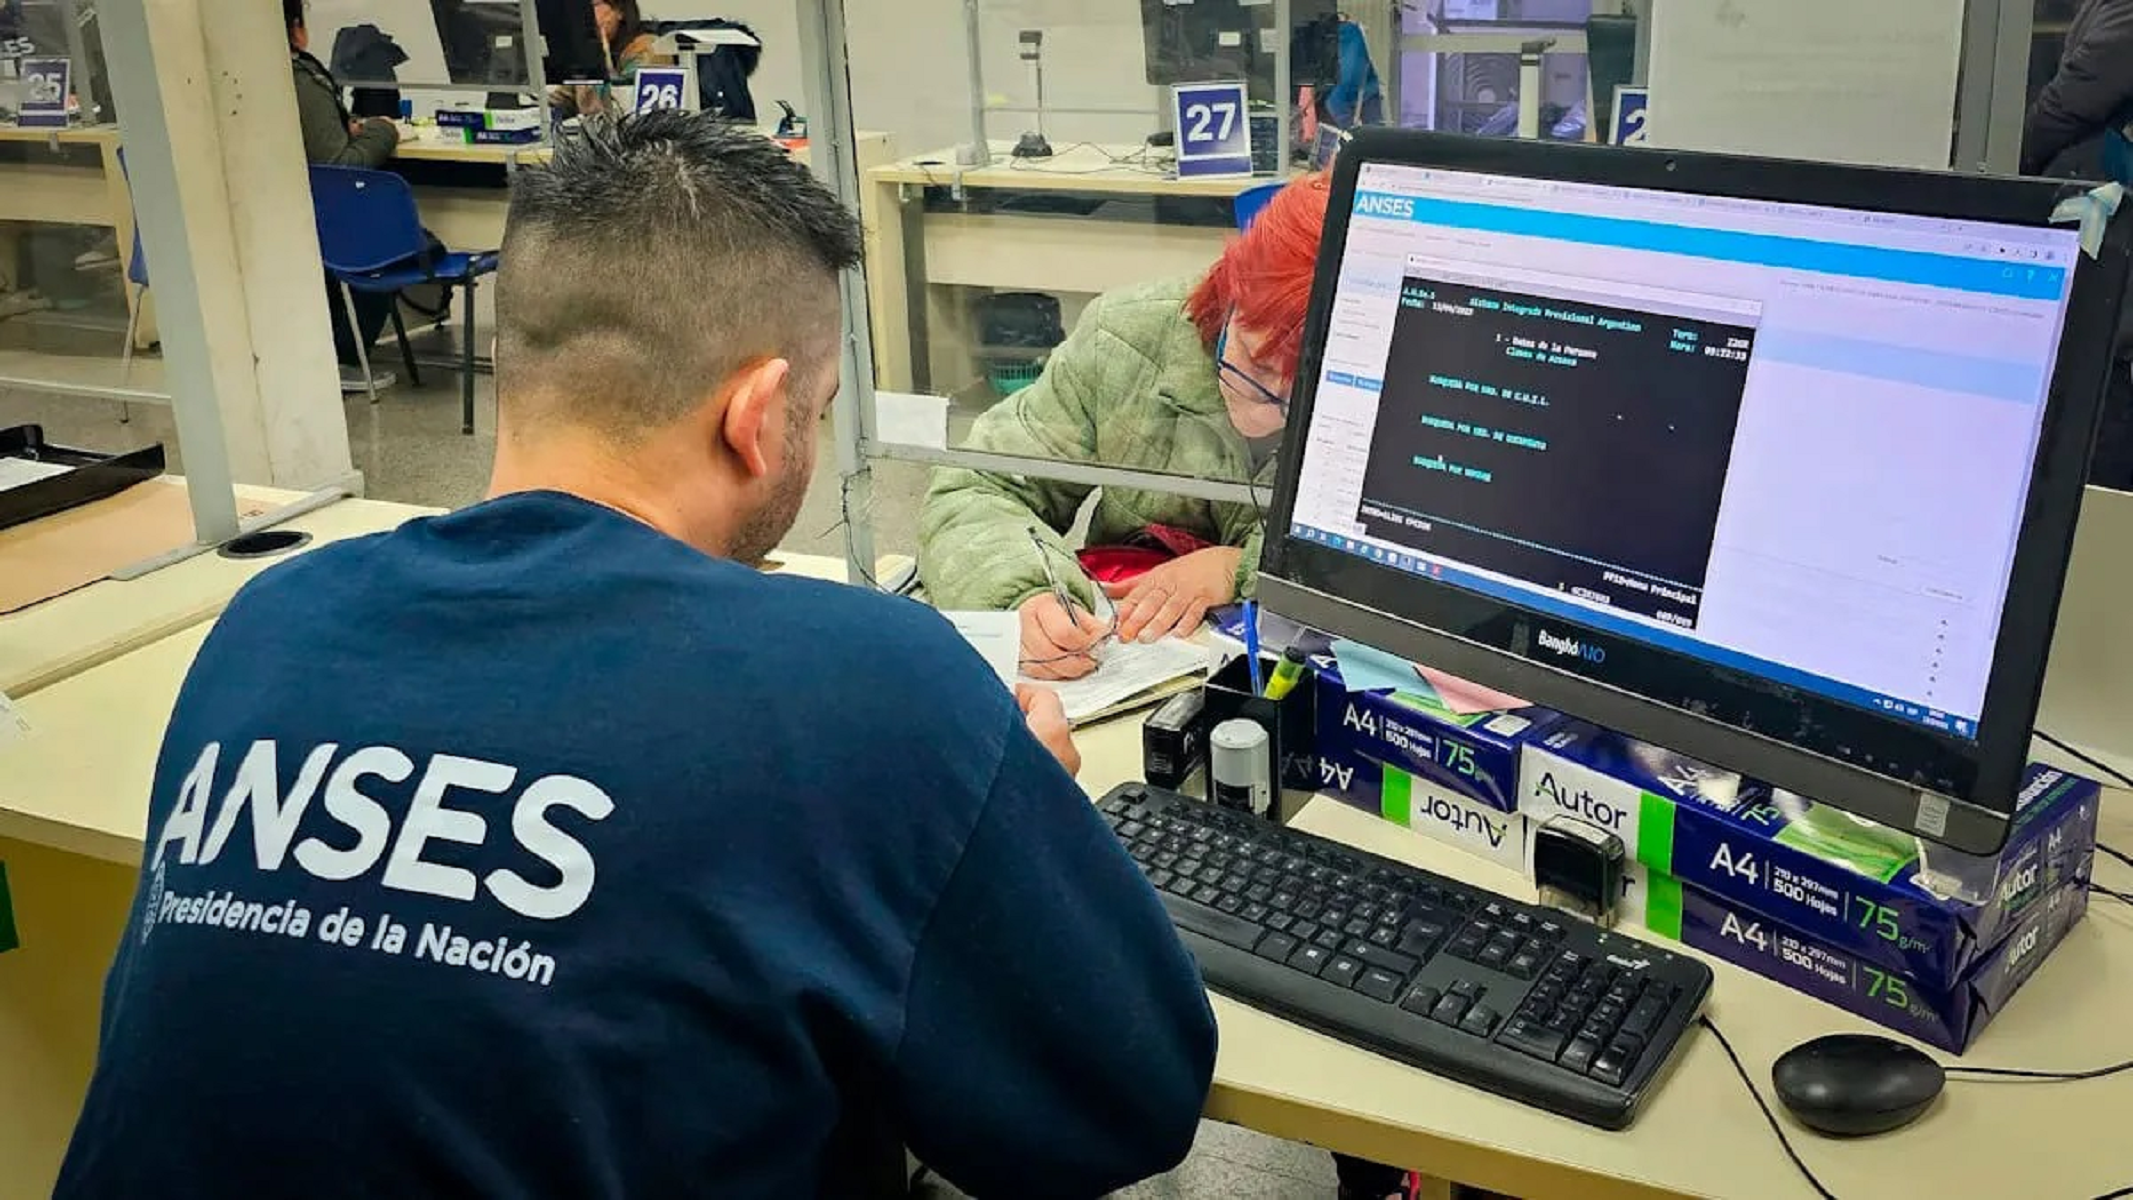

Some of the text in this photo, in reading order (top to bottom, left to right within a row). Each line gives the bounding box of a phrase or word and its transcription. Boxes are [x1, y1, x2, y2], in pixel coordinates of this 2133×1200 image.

[640, 84, 679, 114] 26
[1186, 102, 1236, 142] 27
[1623, 108, 1650, 147] 2
[1355, 195, 1415, 217] ANSES
[1343, 702, 1377, 736] A4
[1318, 756, 1354, 790] A4
[1443, 739, 1475, 775] 75
[1535, 772, 1627, 829] Autor
[150, 739, 616, 920] ANSES
[1420, 795, 1508, 848] Autor
[1709, 842, 1759, 885] A4
[1773, 878, 1804, 902] 500
[156, 890, 310, 938] Presidencia
[319, 912, 367, 948] de
[372, 917, 406, 955] la
[415, 922, 557, 986] Nación
[1720, 911, 1768, 952] A4
[1855, 895, 1900, 941] 75
[1782, 947, 1813, 971] 500
[1863, 965, 1908, 1009] 75
